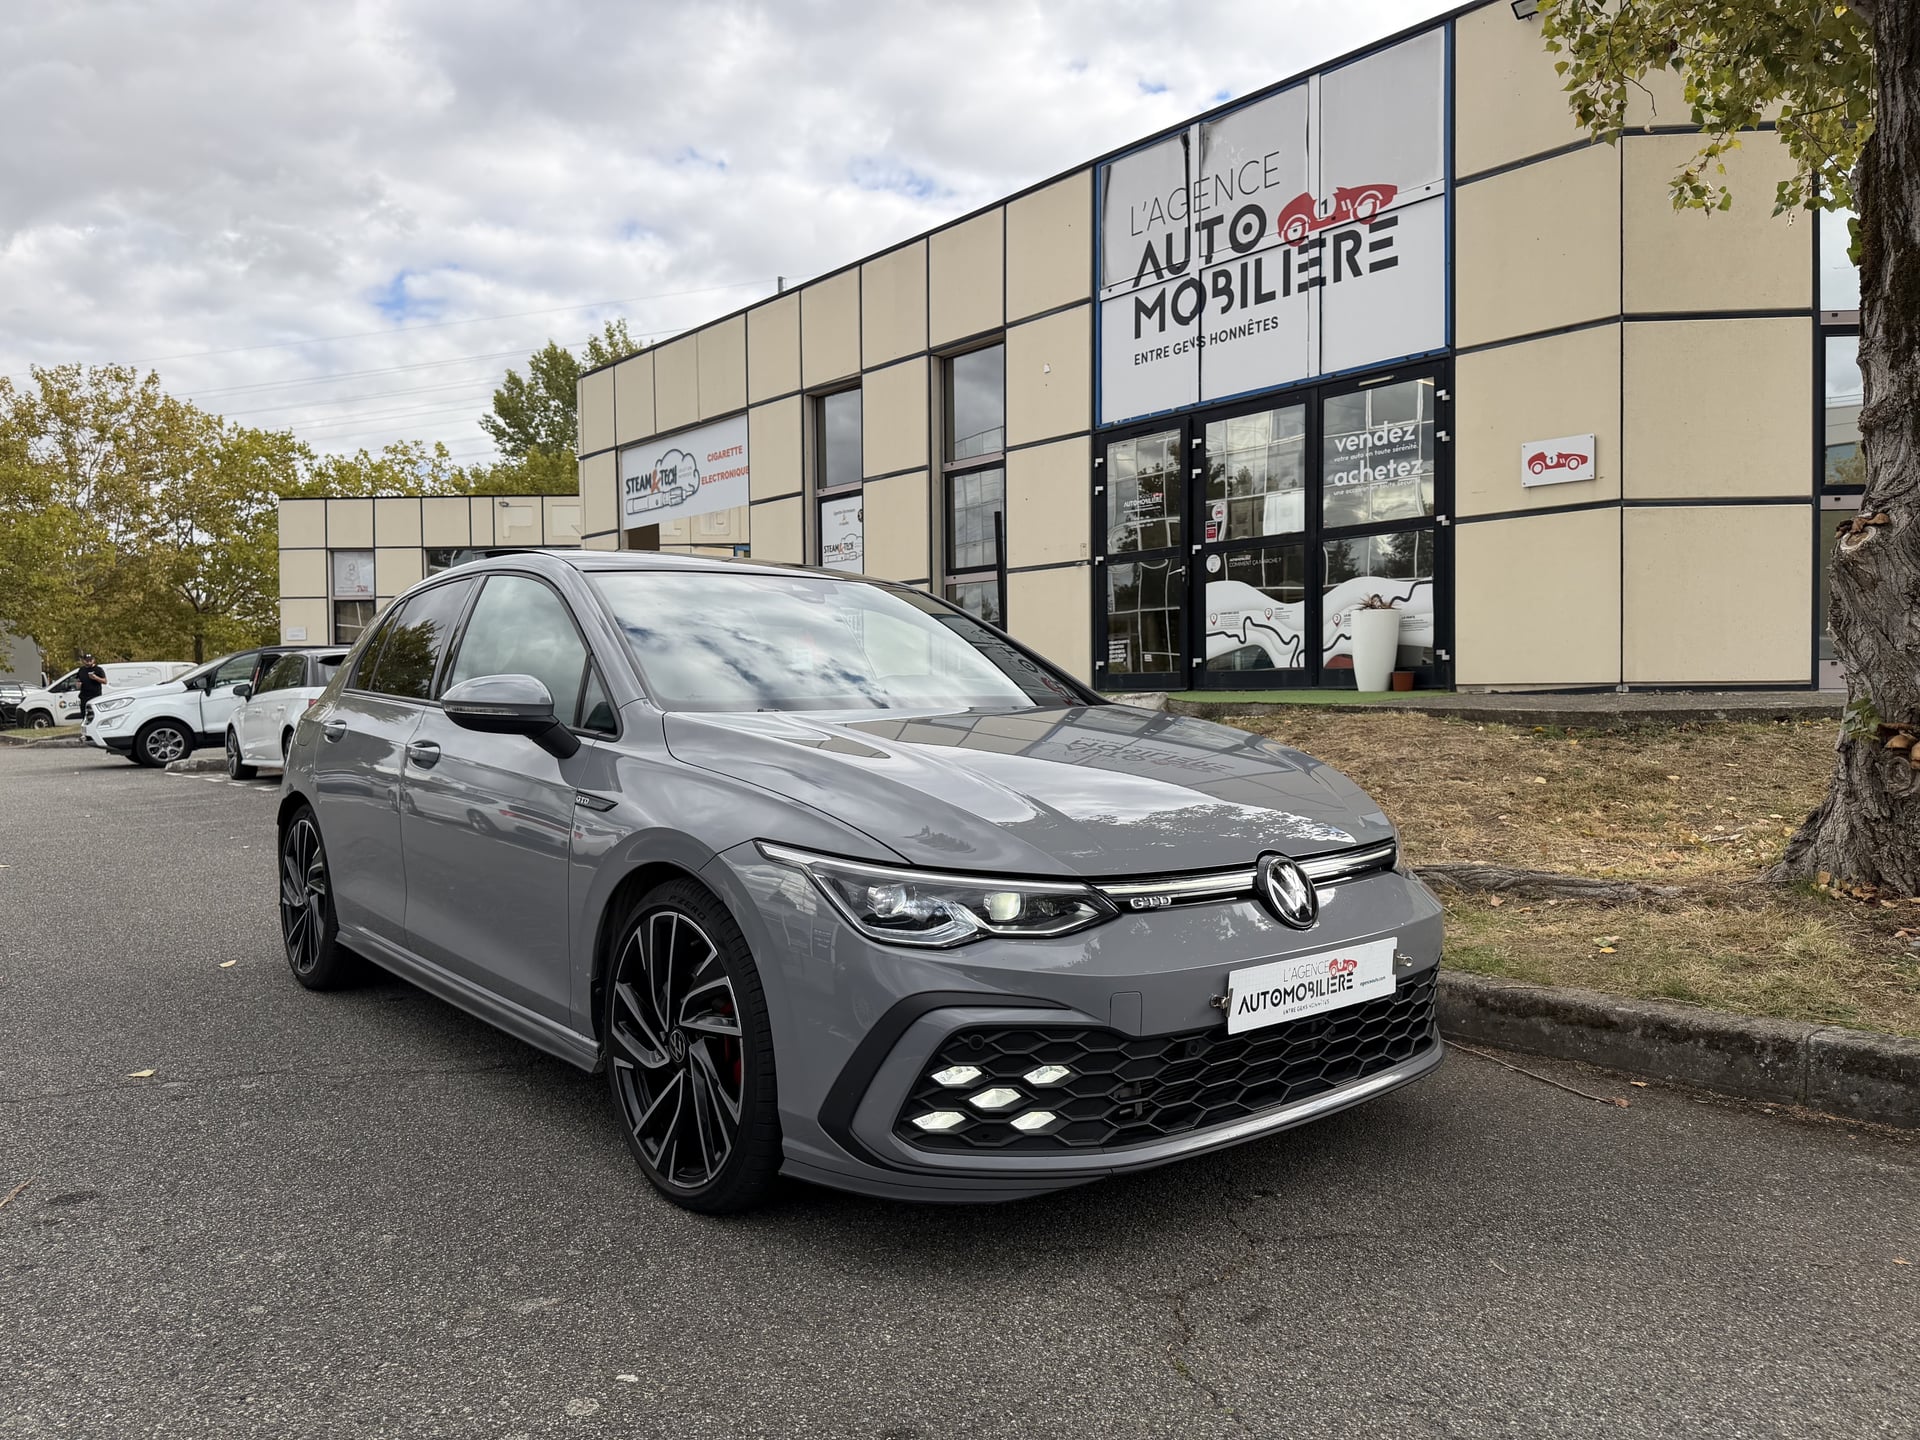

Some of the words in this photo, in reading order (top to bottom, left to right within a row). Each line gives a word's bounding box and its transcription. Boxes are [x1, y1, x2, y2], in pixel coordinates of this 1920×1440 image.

[1131, 151, 1280, 237] L'AGENCE
[1132, 203, 1267, 288] AUTO
[1134, 345, 1170, 366] ENTRE
[1173, 335, 1206, 355] GENS
[1209, 316, 1280, 346] HONNÊTES
[1334, 420, 1416, 452] vendez
[707, 445, 743, 463] CIGARETTE
[1374, 447, 1391, 456] toute
[1334, 459, 1423, 486] achetez
[1283, 959, 1330, 983] L'AGENCE
